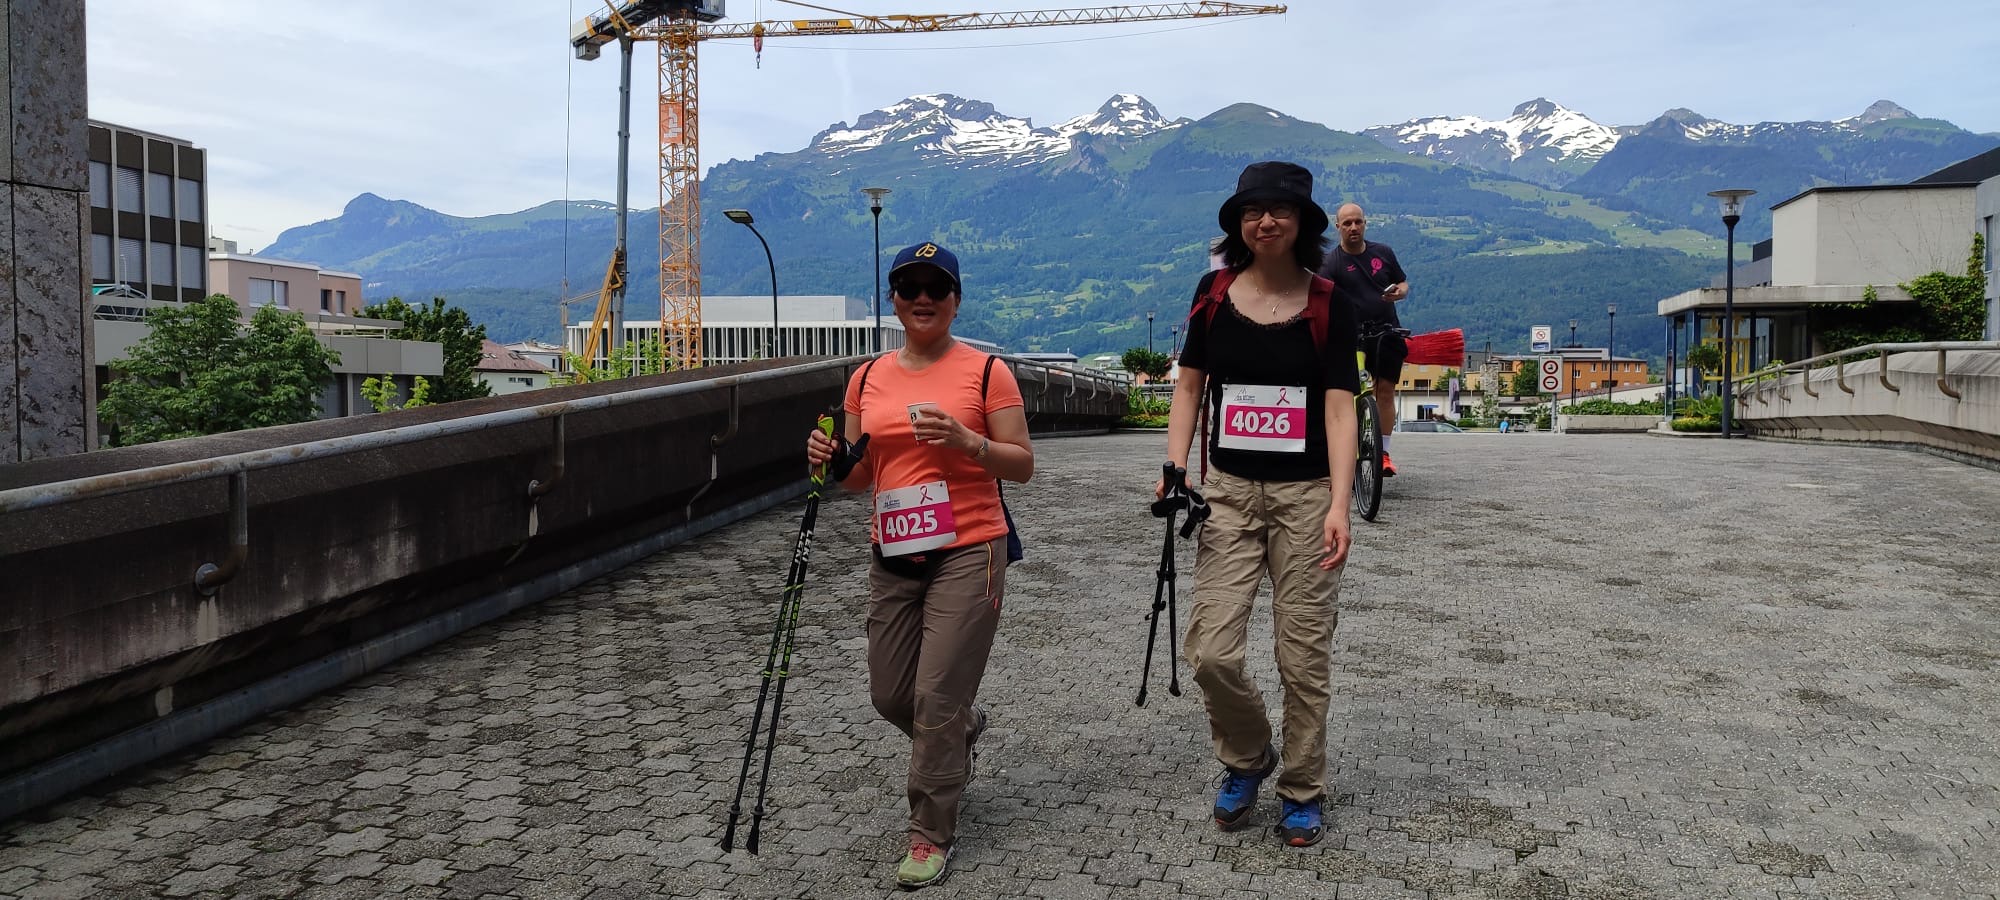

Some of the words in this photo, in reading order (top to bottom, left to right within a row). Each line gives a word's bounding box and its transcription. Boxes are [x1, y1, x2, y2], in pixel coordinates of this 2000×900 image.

[1231, 410, 1291, 435] 4026
[885, 509, 938, 539] 4025
[802, 529, 813, 562] LEKI
